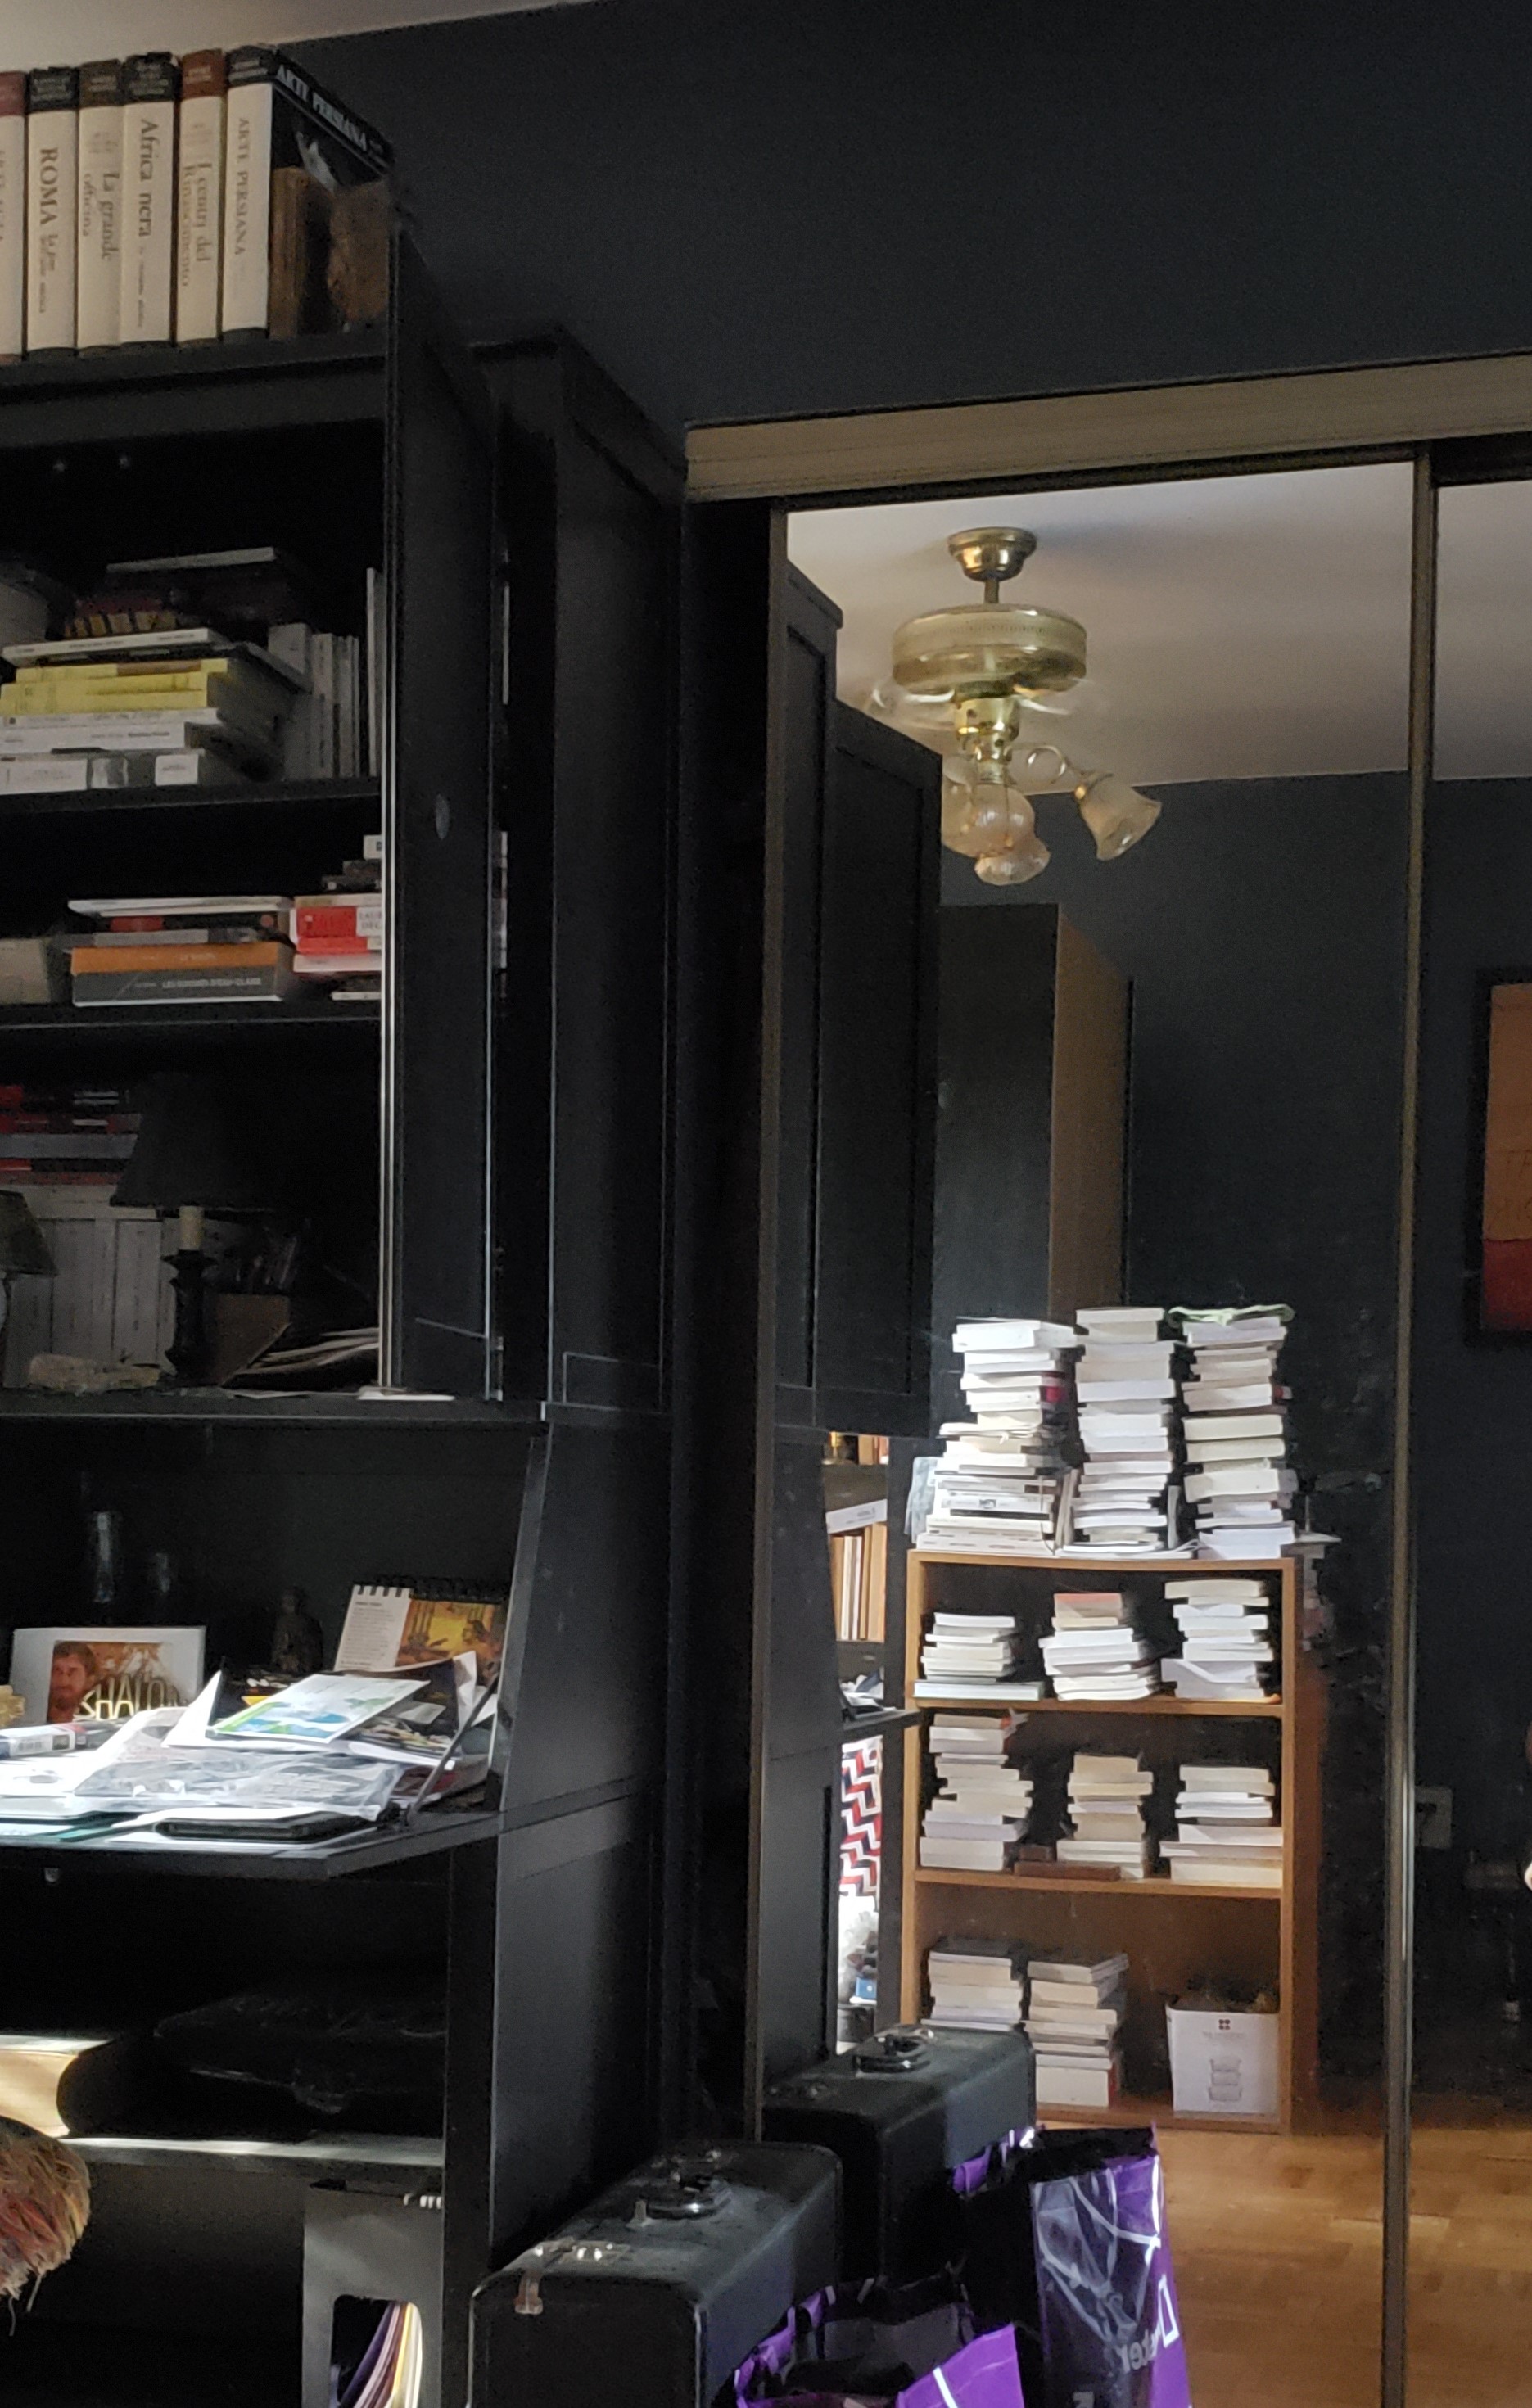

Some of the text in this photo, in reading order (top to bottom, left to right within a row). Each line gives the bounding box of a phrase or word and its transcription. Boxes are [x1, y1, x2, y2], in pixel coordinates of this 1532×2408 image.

[39, 147, 59, 226] ROMA
[102, 172, 120, 192] La
[138, 118, 160, 237] Africa nera
[234, 171, 250, 255] PERSIANA
[97, 200, 119, 262] grande
